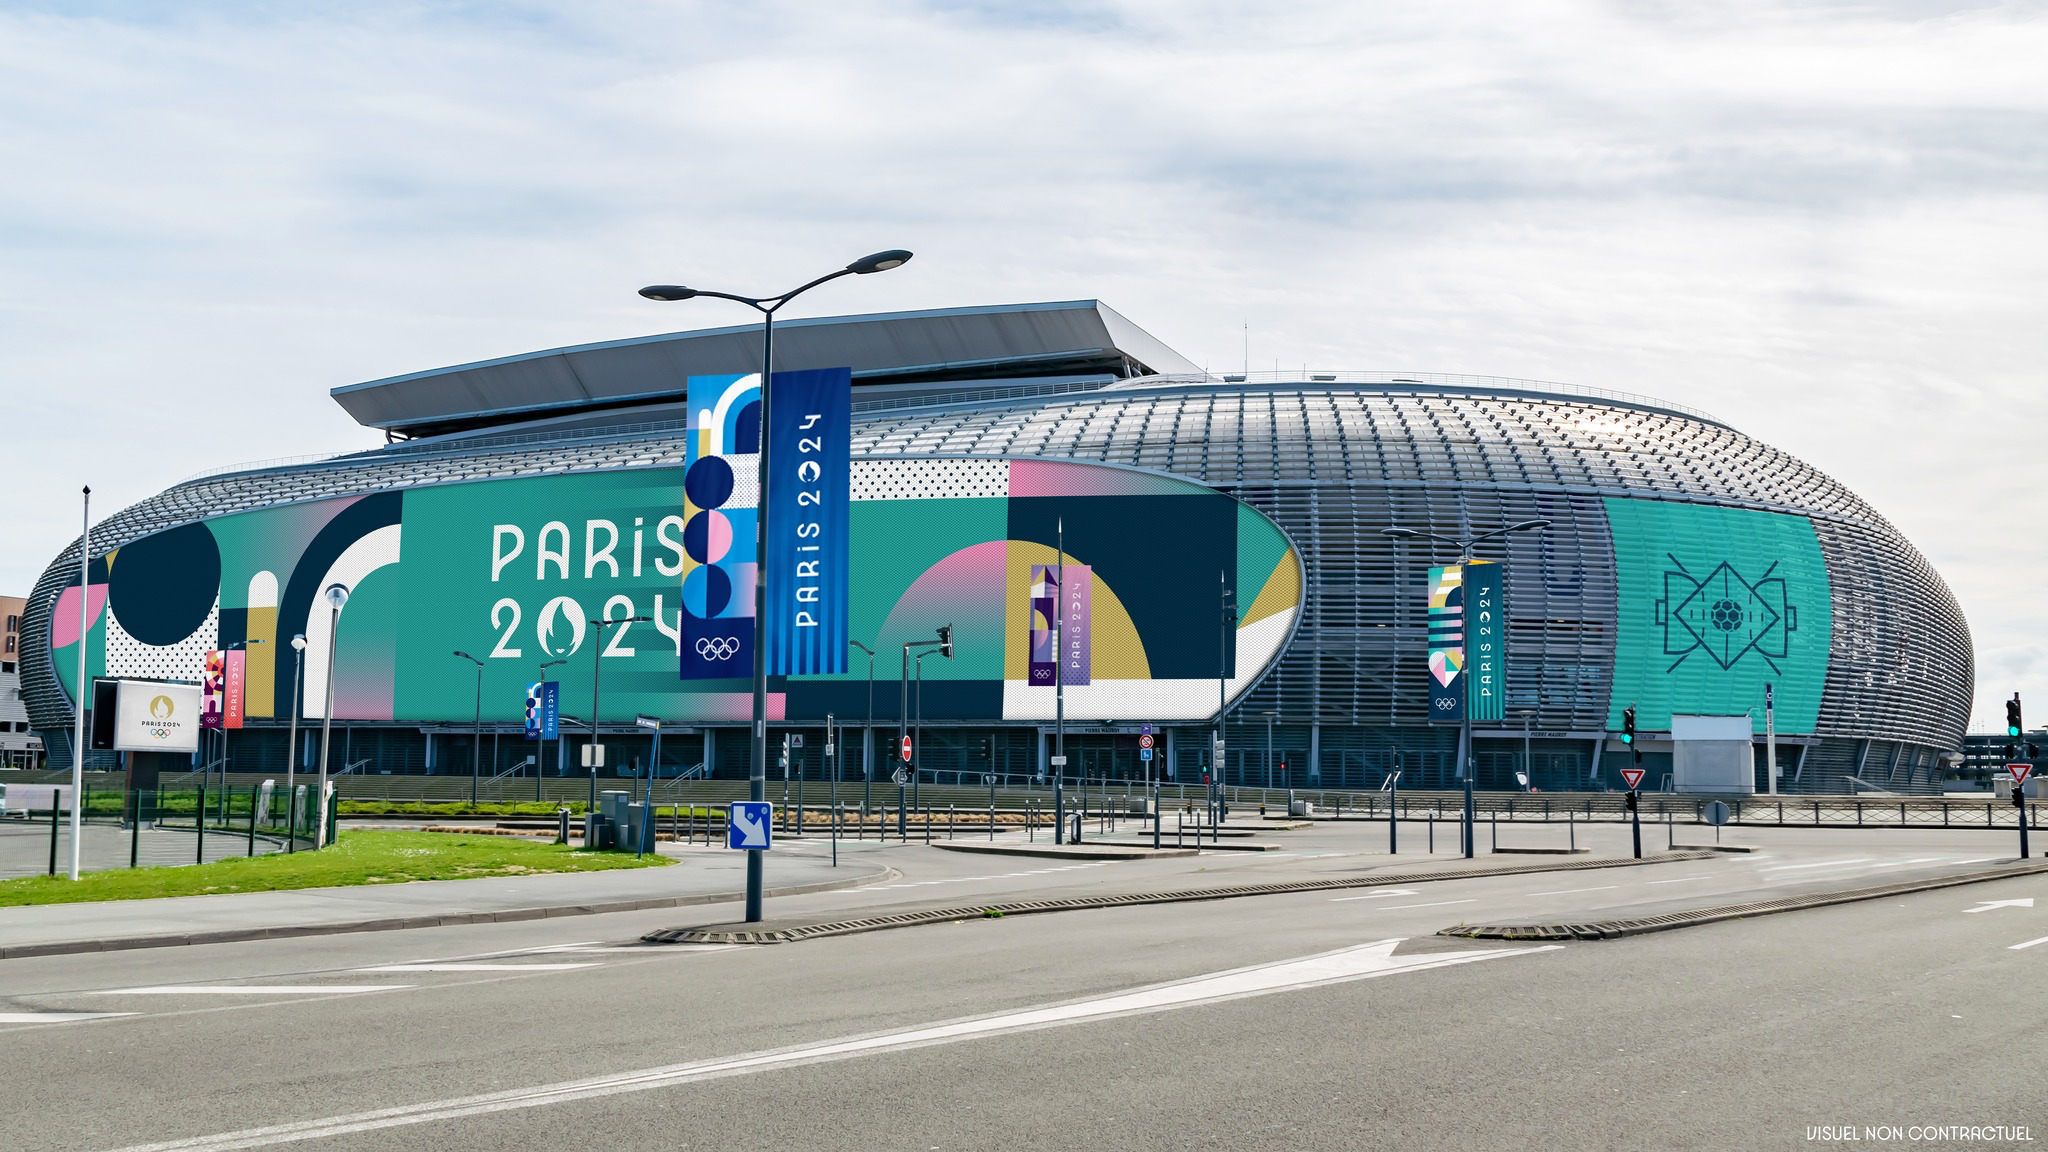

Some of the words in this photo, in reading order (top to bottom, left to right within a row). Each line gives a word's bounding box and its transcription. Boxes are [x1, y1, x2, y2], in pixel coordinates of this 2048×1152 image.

[797, 414, 822, 506] 2024
[489, 594, 682, 658] 2024
[1072, 583, 1081, 620] 2024
[1479, 587, 1491, 635] 2024
